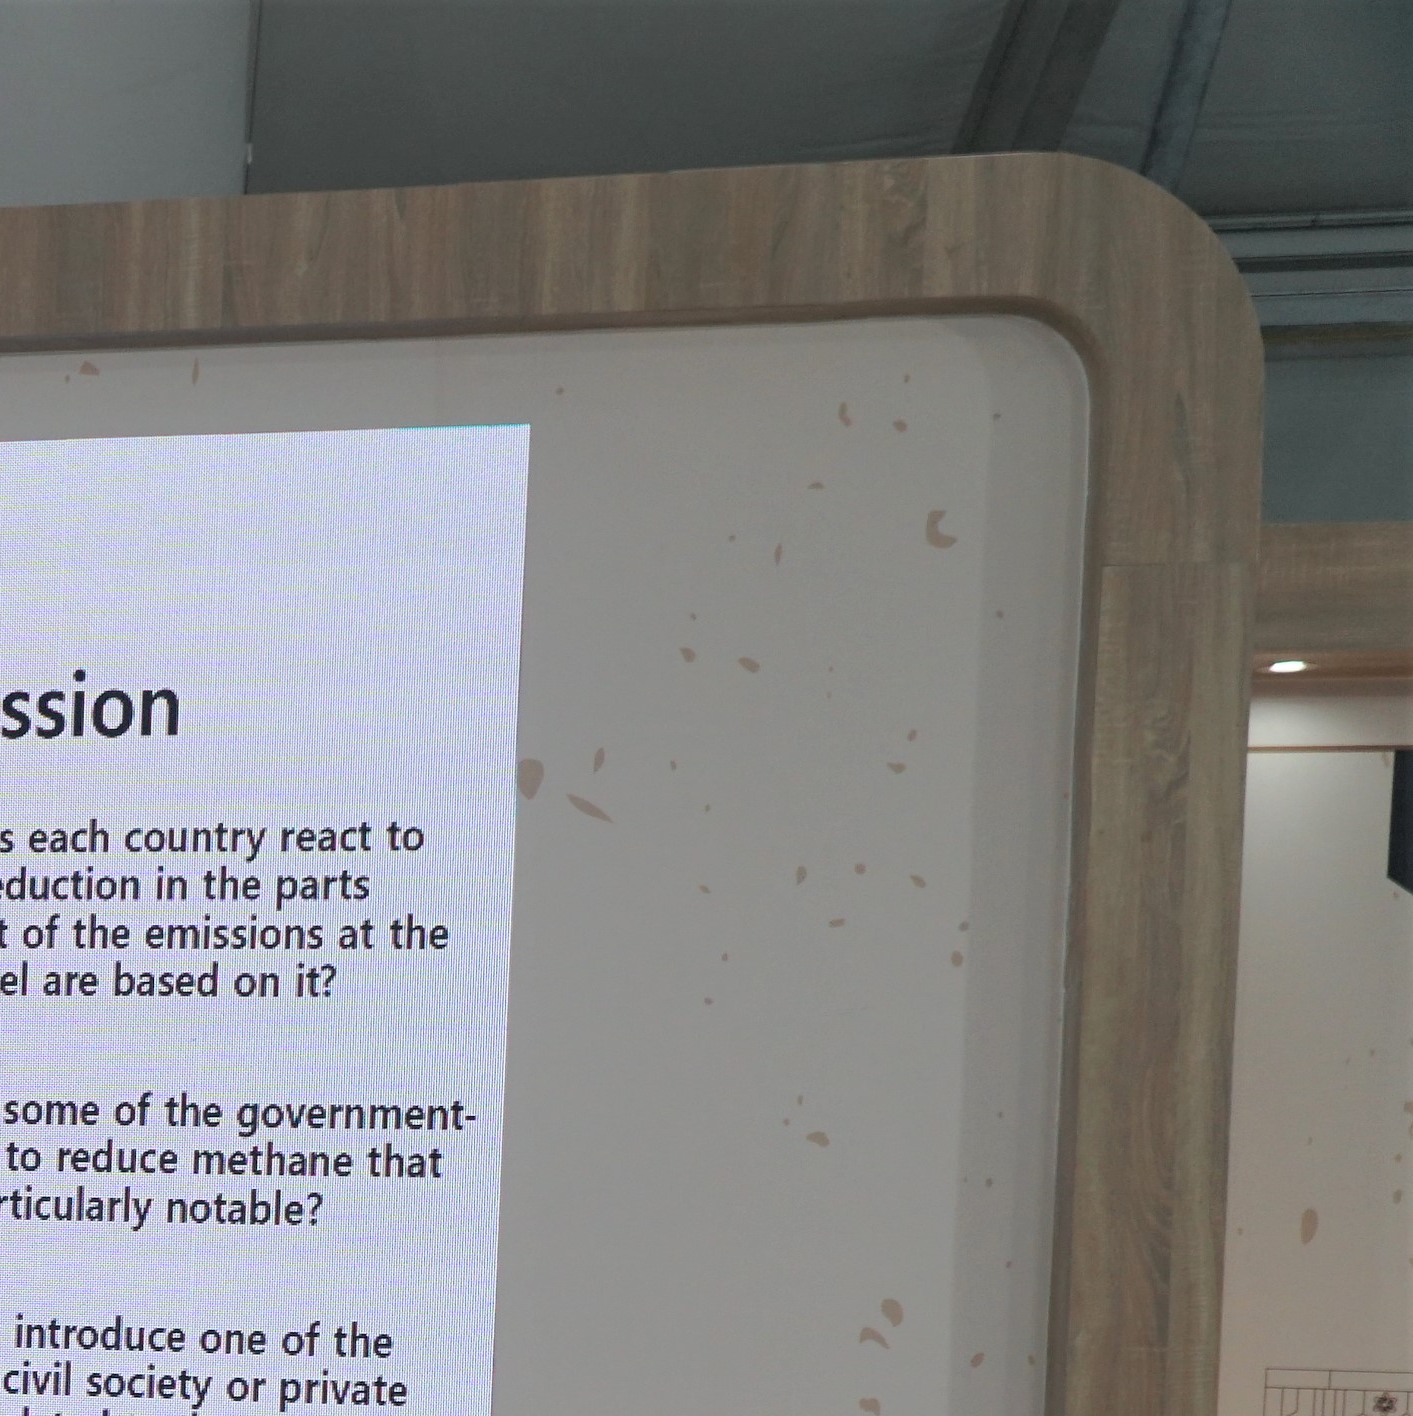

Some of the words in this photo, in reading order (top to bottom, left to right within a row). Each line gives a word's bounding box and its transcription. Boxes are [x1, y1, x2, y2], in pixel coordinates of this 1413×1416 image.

[28, 818, 109, 854] each
[124, 822, 267, 863] country
[281, 821, 372, 853] react
[386, 821, 425, 852] to
[156, 865, 188, 901] in
[203, 865, 261, 901] the
[276, 869, 370, 911] parts
[22, 913, 60, 950] of
[72, 913, 130, 950] the
[145, 914, 324, 950] emissions
[338, 919, 374, 950] at
[389, 913, 449, 950] the
[43, 971, 99, 997] are
[114, 960, 219, 998] based
[233, 972, 280, 998] on
[296, 962, 337, 998] it?
[4, 1100, 100, 1126] some
[114, 1091, 153, 1127] of
[164, 1091, 223, 1128] the
[236, 1100, 477, 1138] government-
[6, 1142, 42, 1172] to
[57, 1138, 178, 1174] reduce
[193, 1141, 353, 1178] methane
[367, 1142, 443, 1179] that
[167, 1188, 324, 1226] notable?
[15, 1313, 186, 1353] introduce
[199, 1328, 267, 1356] one
[281, 1320, 321, 1357] of
[334, 1321, 393, 1359] the
[2, 1360, 72, 1396] civil
[86, 1363, 213, 1411] society
[226, 1376, 267, 1403] or
[279, 1369, 408, 1413] private
